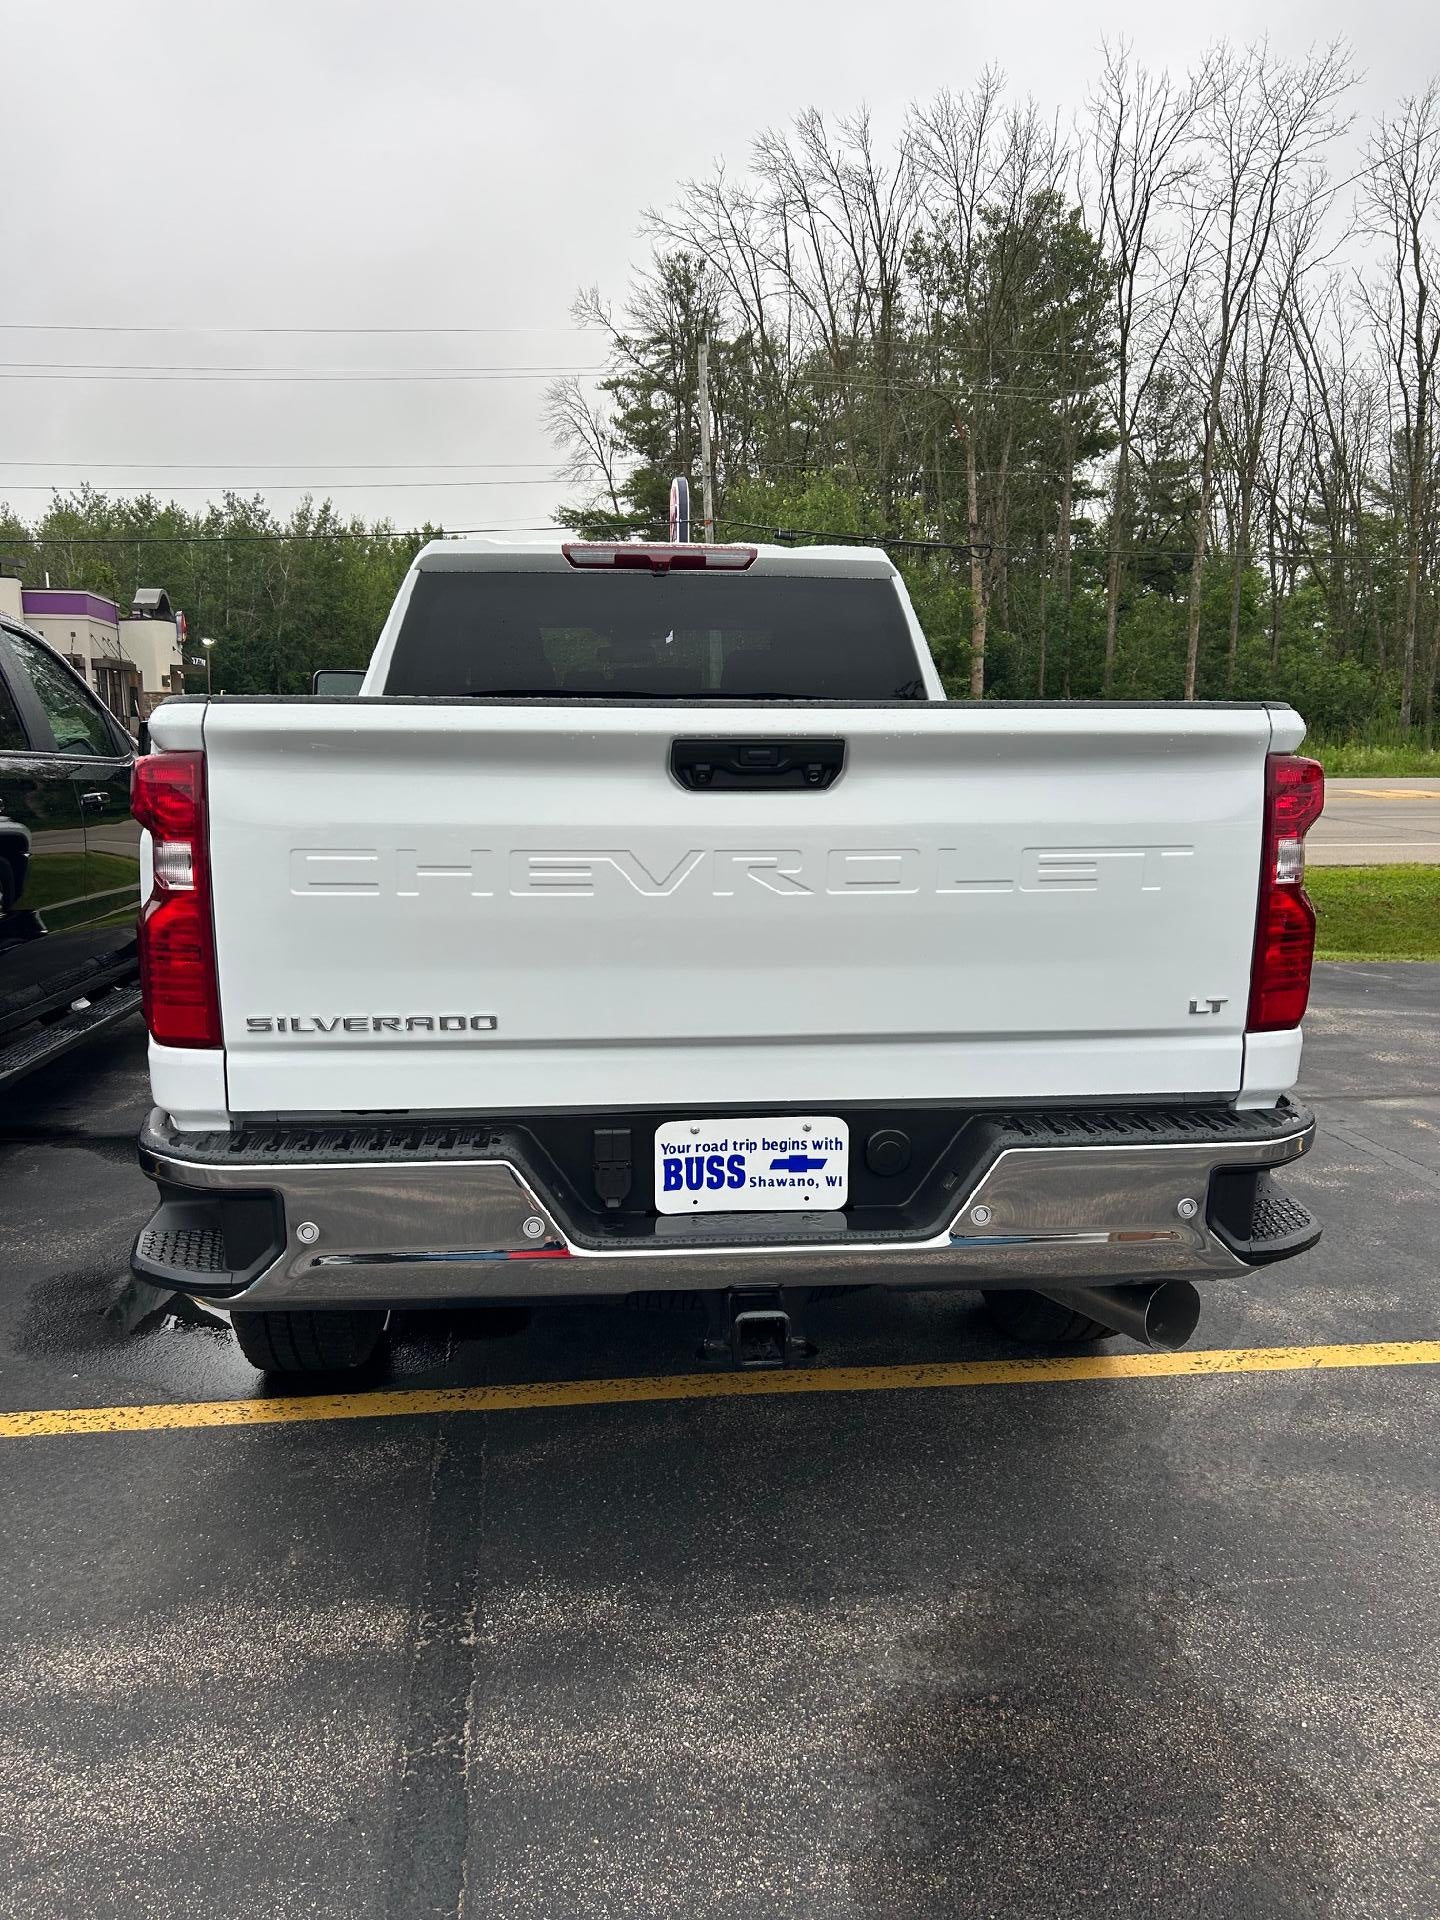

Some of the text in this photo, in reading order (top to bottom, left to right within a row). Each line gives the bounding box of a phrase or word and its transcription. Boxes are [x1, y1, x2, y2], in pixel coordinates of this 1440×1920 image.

[289, 844, 1195, 897] CHEVROLET
[1189, 996, 1229, 1014] LT
[246, 1015, 498, 1032] SILVERADO
[661, 1136, 843, 1155] Your road trip begins with
[663, 1154, 746, 1191] BUSS
[749, 1175, 842, 1188] Shawano, WI
